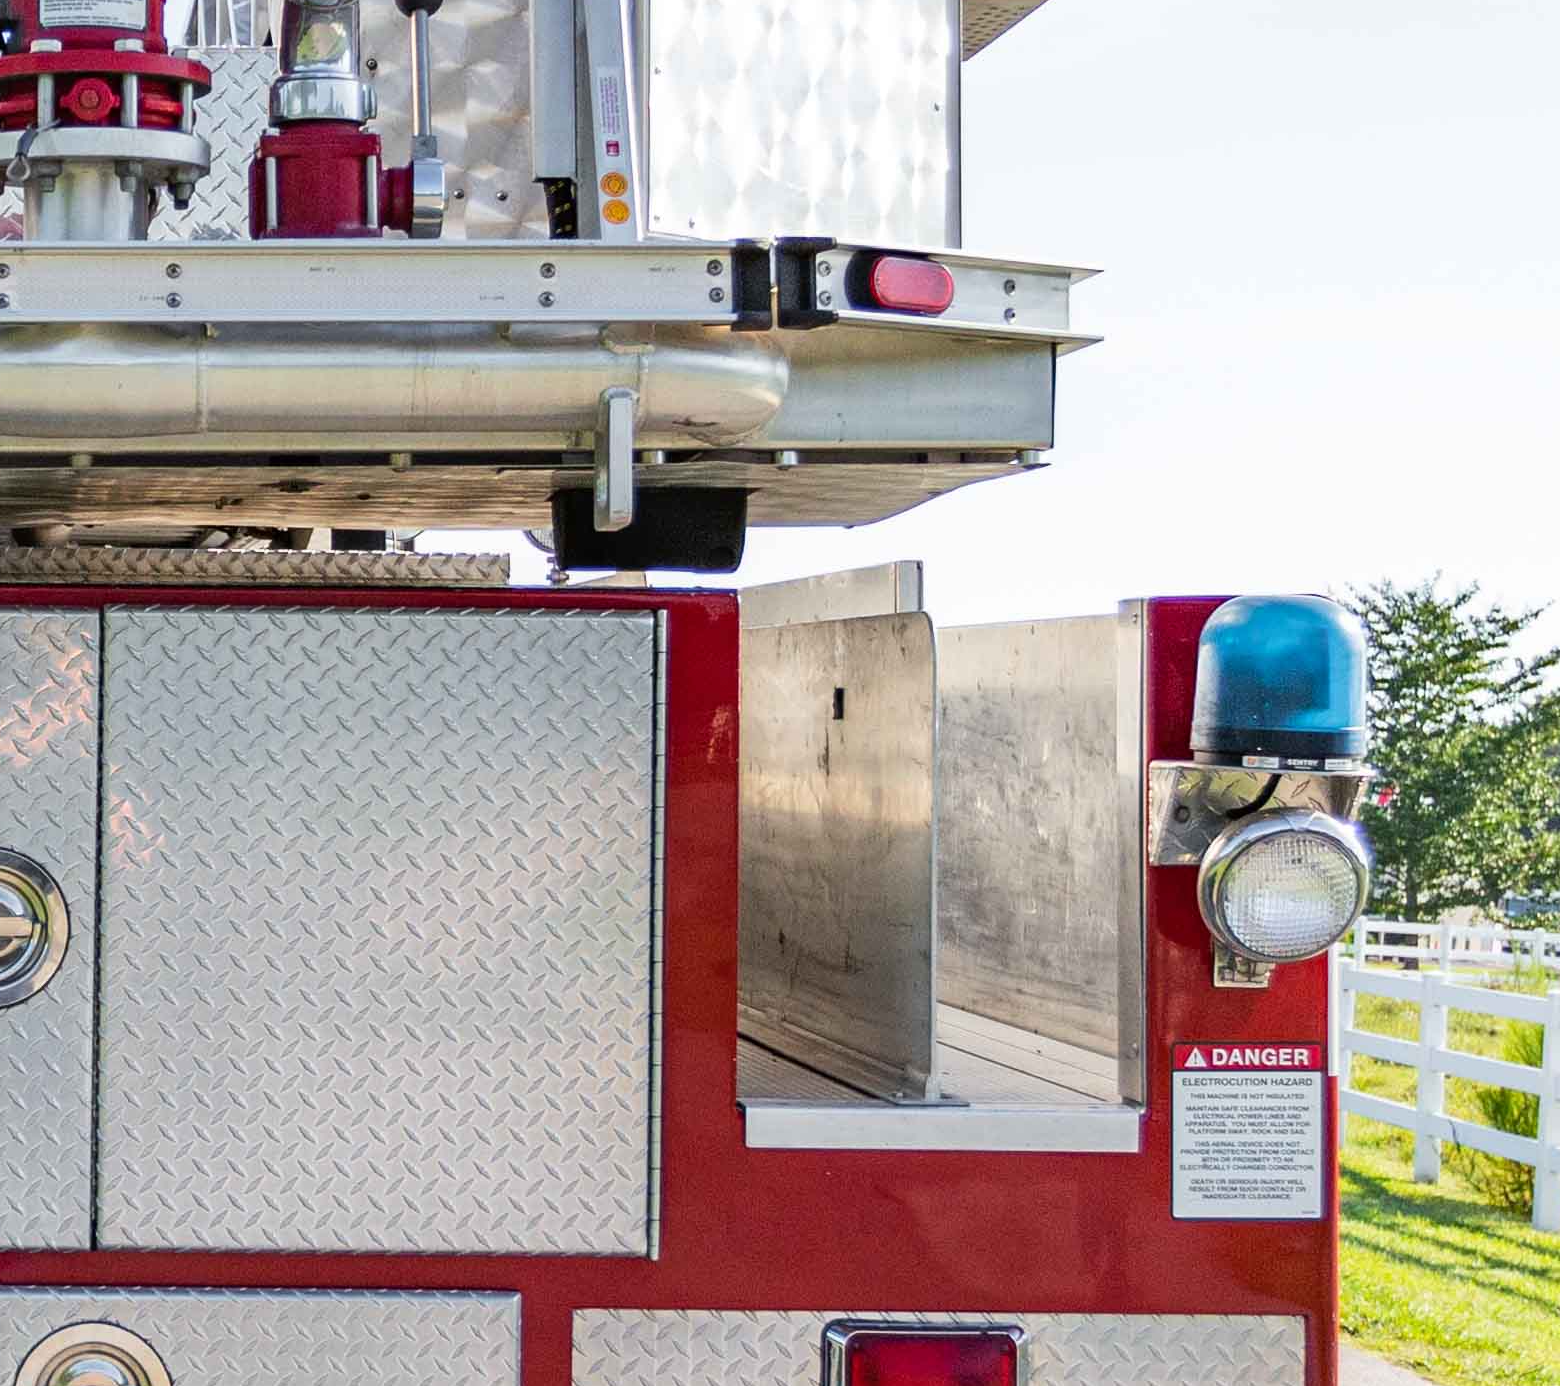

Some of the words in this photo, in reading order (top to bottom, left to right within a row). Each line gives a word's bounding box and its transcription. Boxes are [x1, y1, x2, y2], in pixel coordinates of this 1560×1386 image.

[1287, 758, 1319, 766] SENTRY
[1212, 1048, 1310, 1066] DANGER
[1182, 1077, 1268, 1086] ELECTROCUTION
[1270, 1077, 1313, 1086] HAZARD
